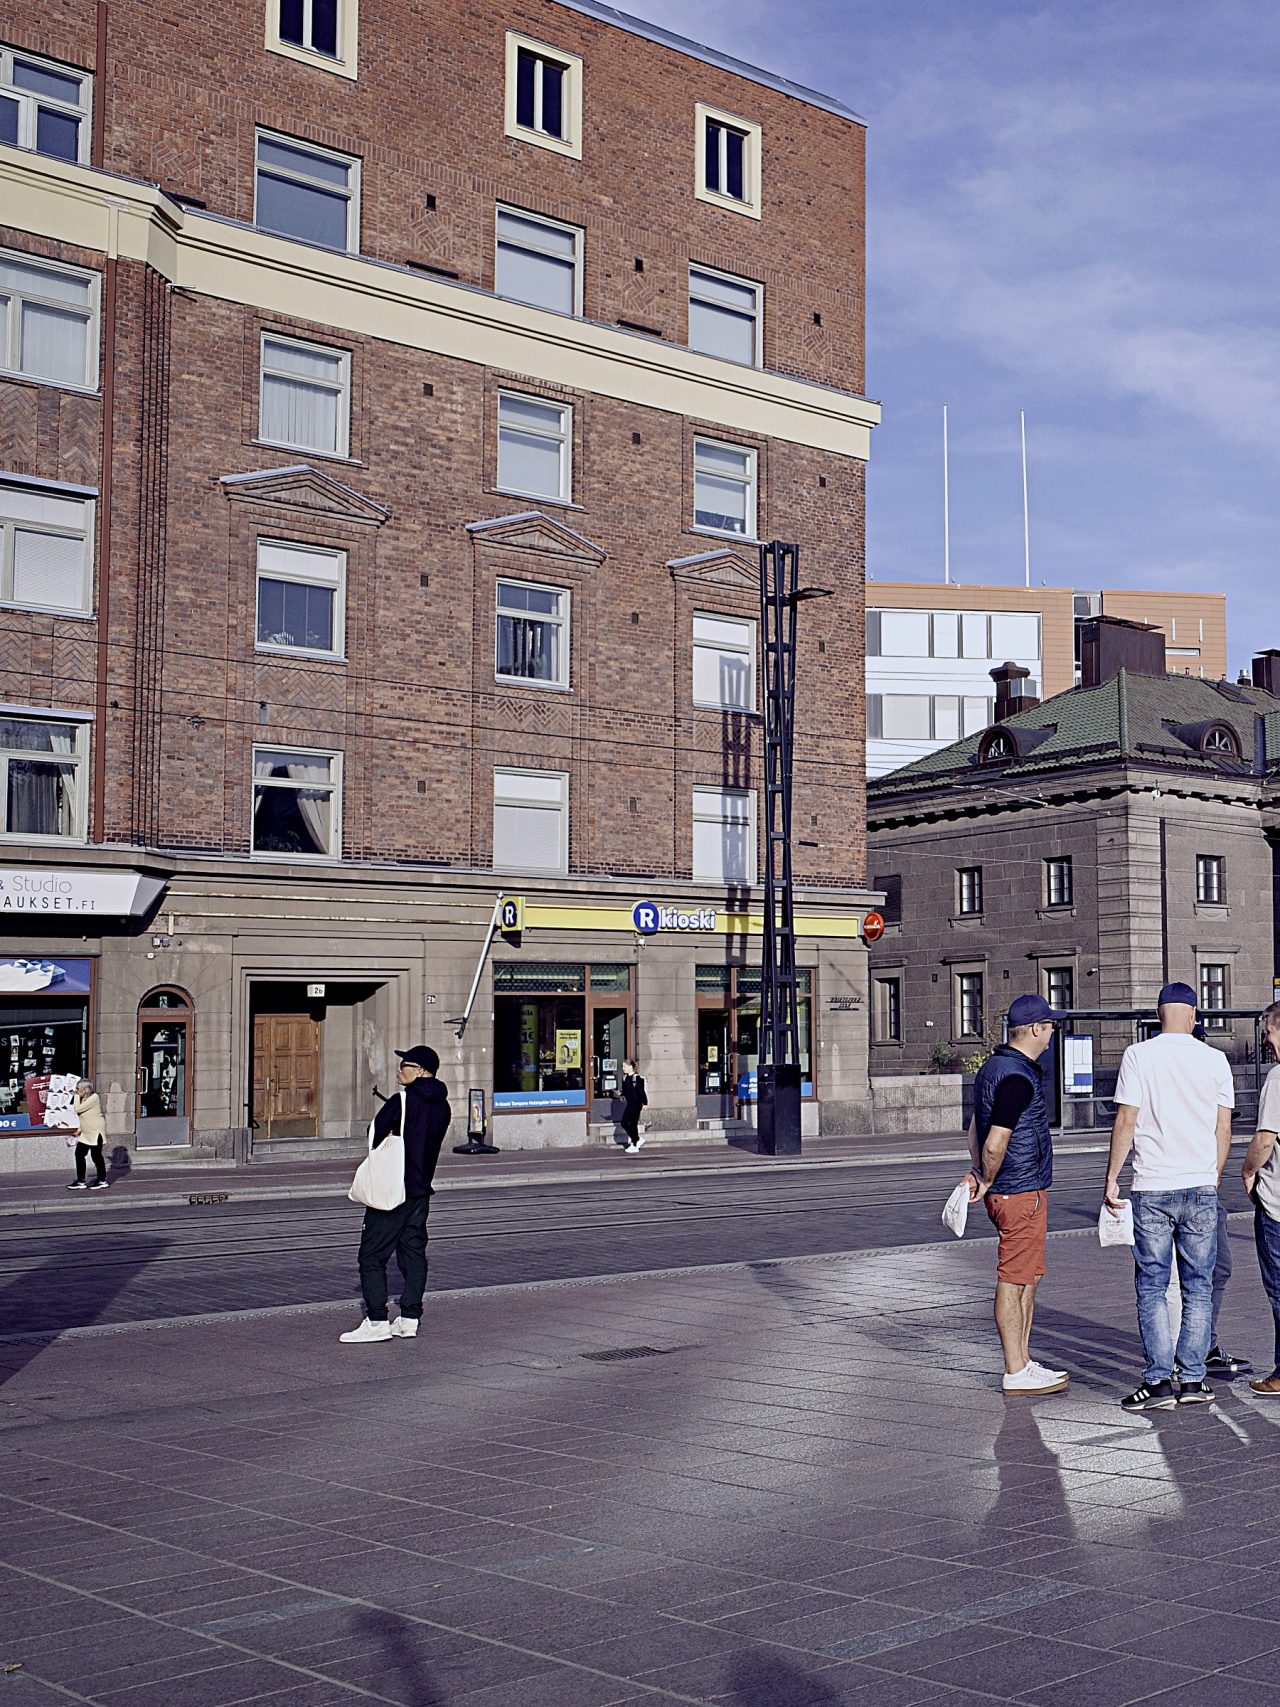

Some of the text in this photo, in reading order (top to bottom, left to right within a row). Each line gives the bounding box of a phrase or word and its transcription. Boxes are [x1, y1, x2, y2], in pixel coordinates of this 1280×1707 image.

[13, 874, 72, 894] Studio
[3, 896, 95, 910] AUKSET.FI
[505, 906, 514, 924] R
[639, 908, 716, 930] R kioski
[314, 986, 323, 995] 2b
